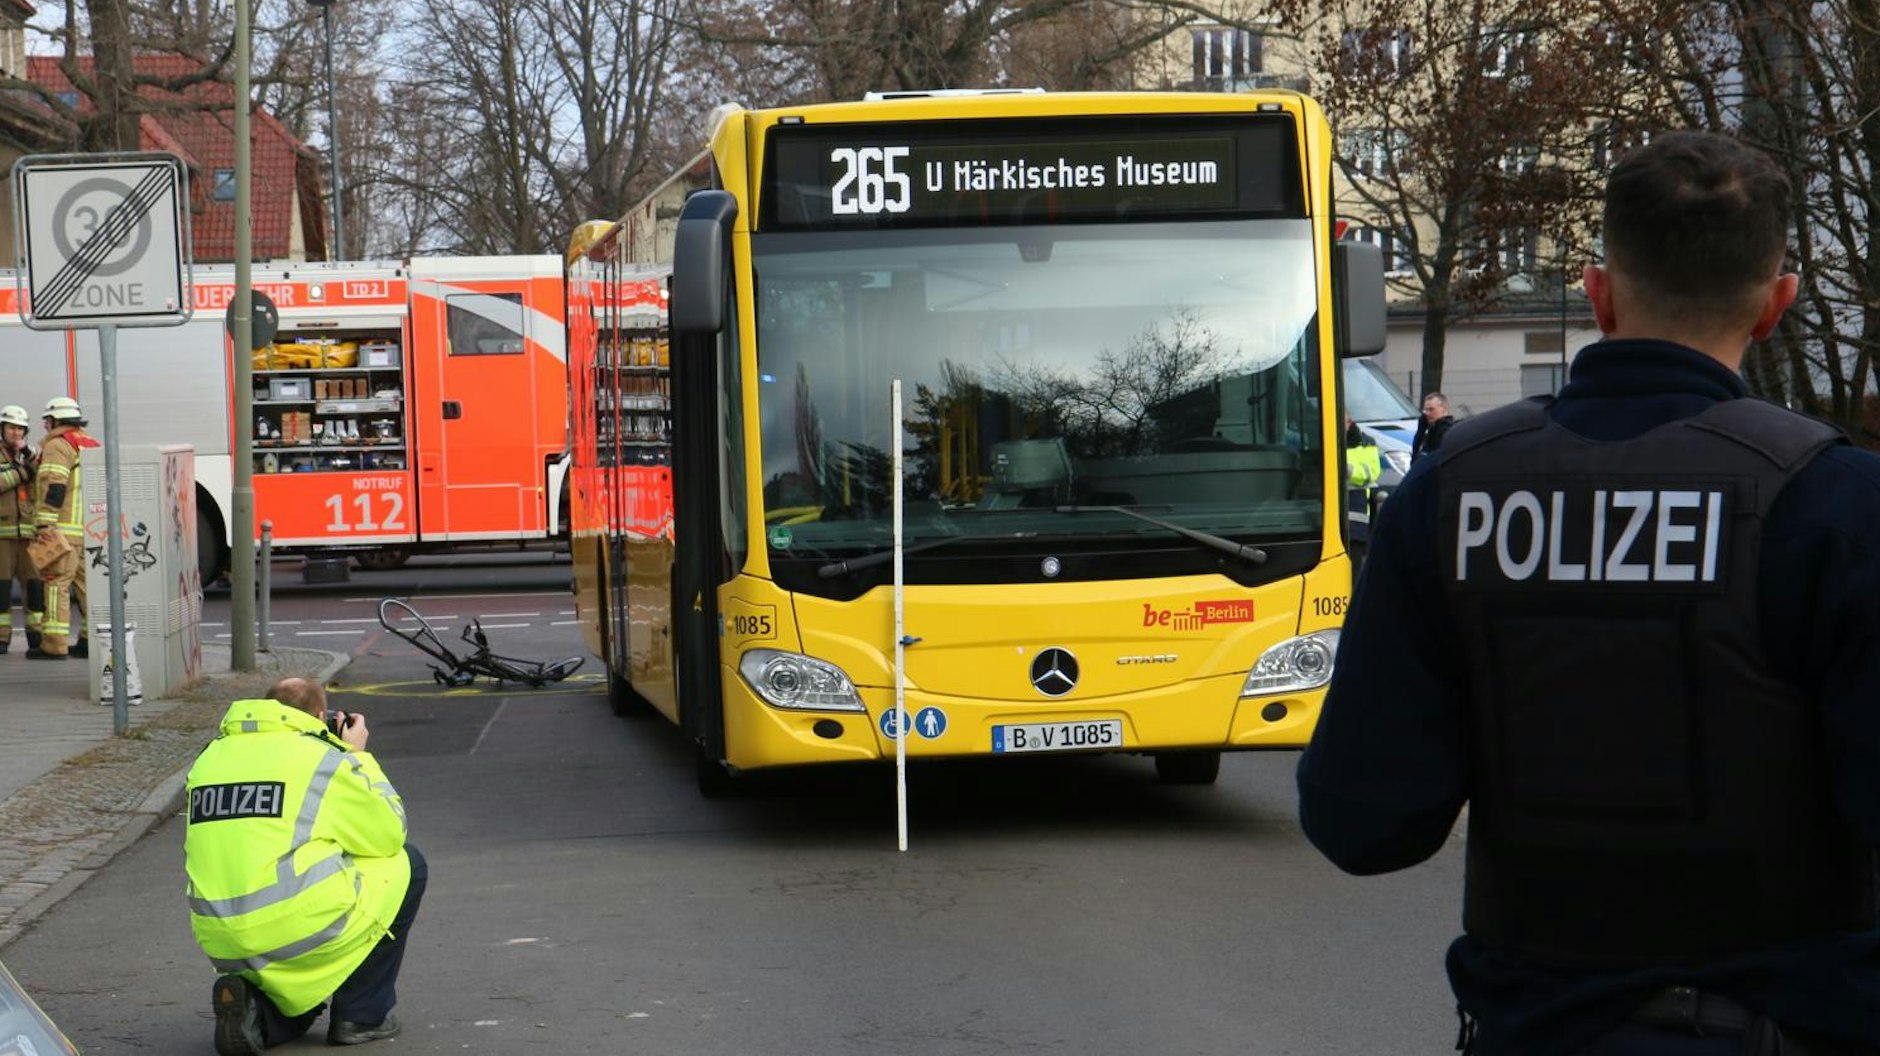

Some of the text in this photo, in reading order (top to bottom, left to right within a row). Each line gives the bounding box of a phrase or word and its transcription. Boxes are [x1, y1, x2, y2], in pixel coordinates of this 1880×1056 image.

[831, 146, 1218, 214] 265 U Märkisches Museum
[73, 205, 131, 249] 30
[70, 282, 144, 308] ZONE
[352, 477, 404, 490] NOTRUF
[325, 492, 405, 532] 112
[1456, 490, 1722, 581] POLIZEI
[735, 615, 771, 635] 1085
[1143, 603, 1248, 627] be Berlin
[1013, 728, 1027, 748] B
[1042, 727, 1054, 747] V
[1060, 723, 1113, 747] 1085
[192, 784, 281, 819] POLIZEI
